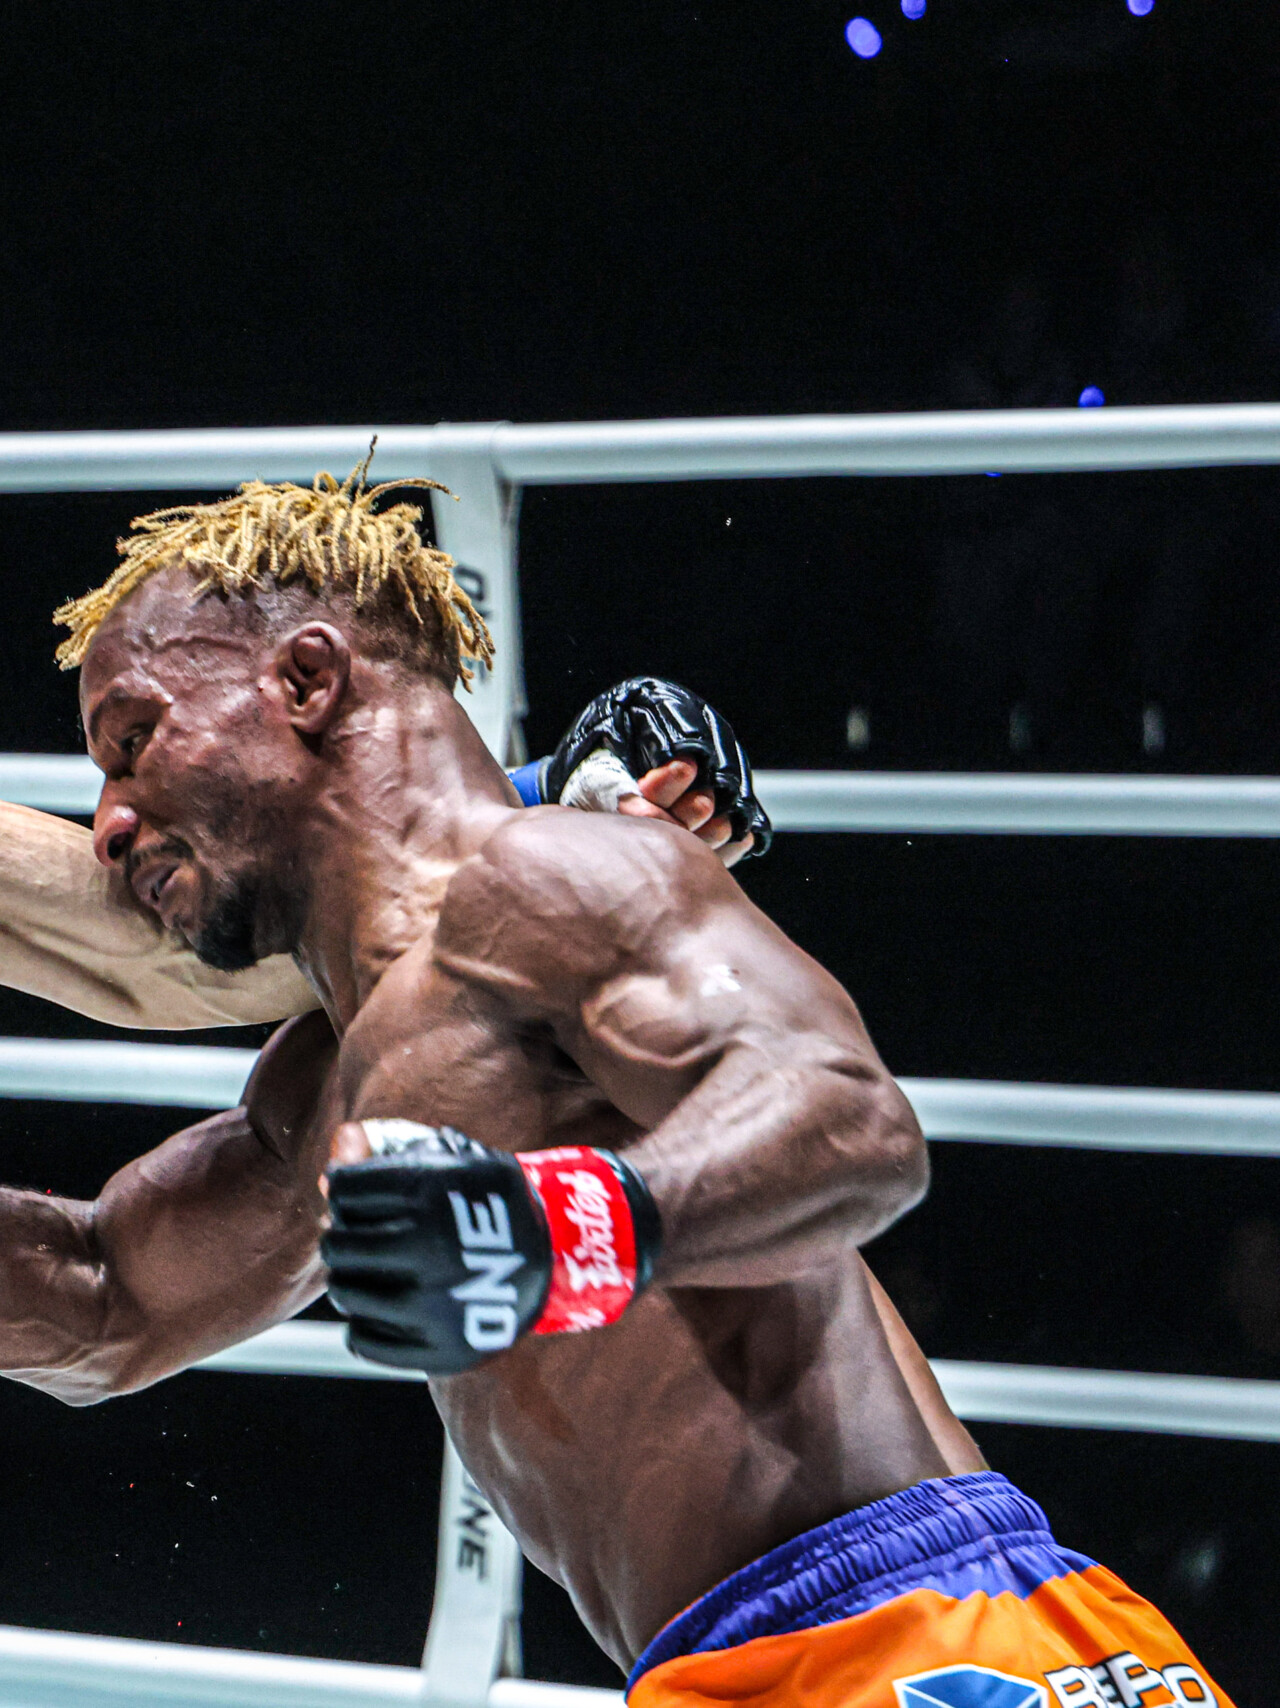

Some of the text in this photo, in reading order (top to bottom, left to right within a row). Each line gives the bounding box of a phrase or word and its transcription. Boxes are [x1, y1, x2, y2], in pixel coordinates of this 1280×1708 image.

[447, 1190, 526, 1350] ONE
[556, 1169, 624, 1293] Fairtex
[457, 1471, 492, 1582] NE
